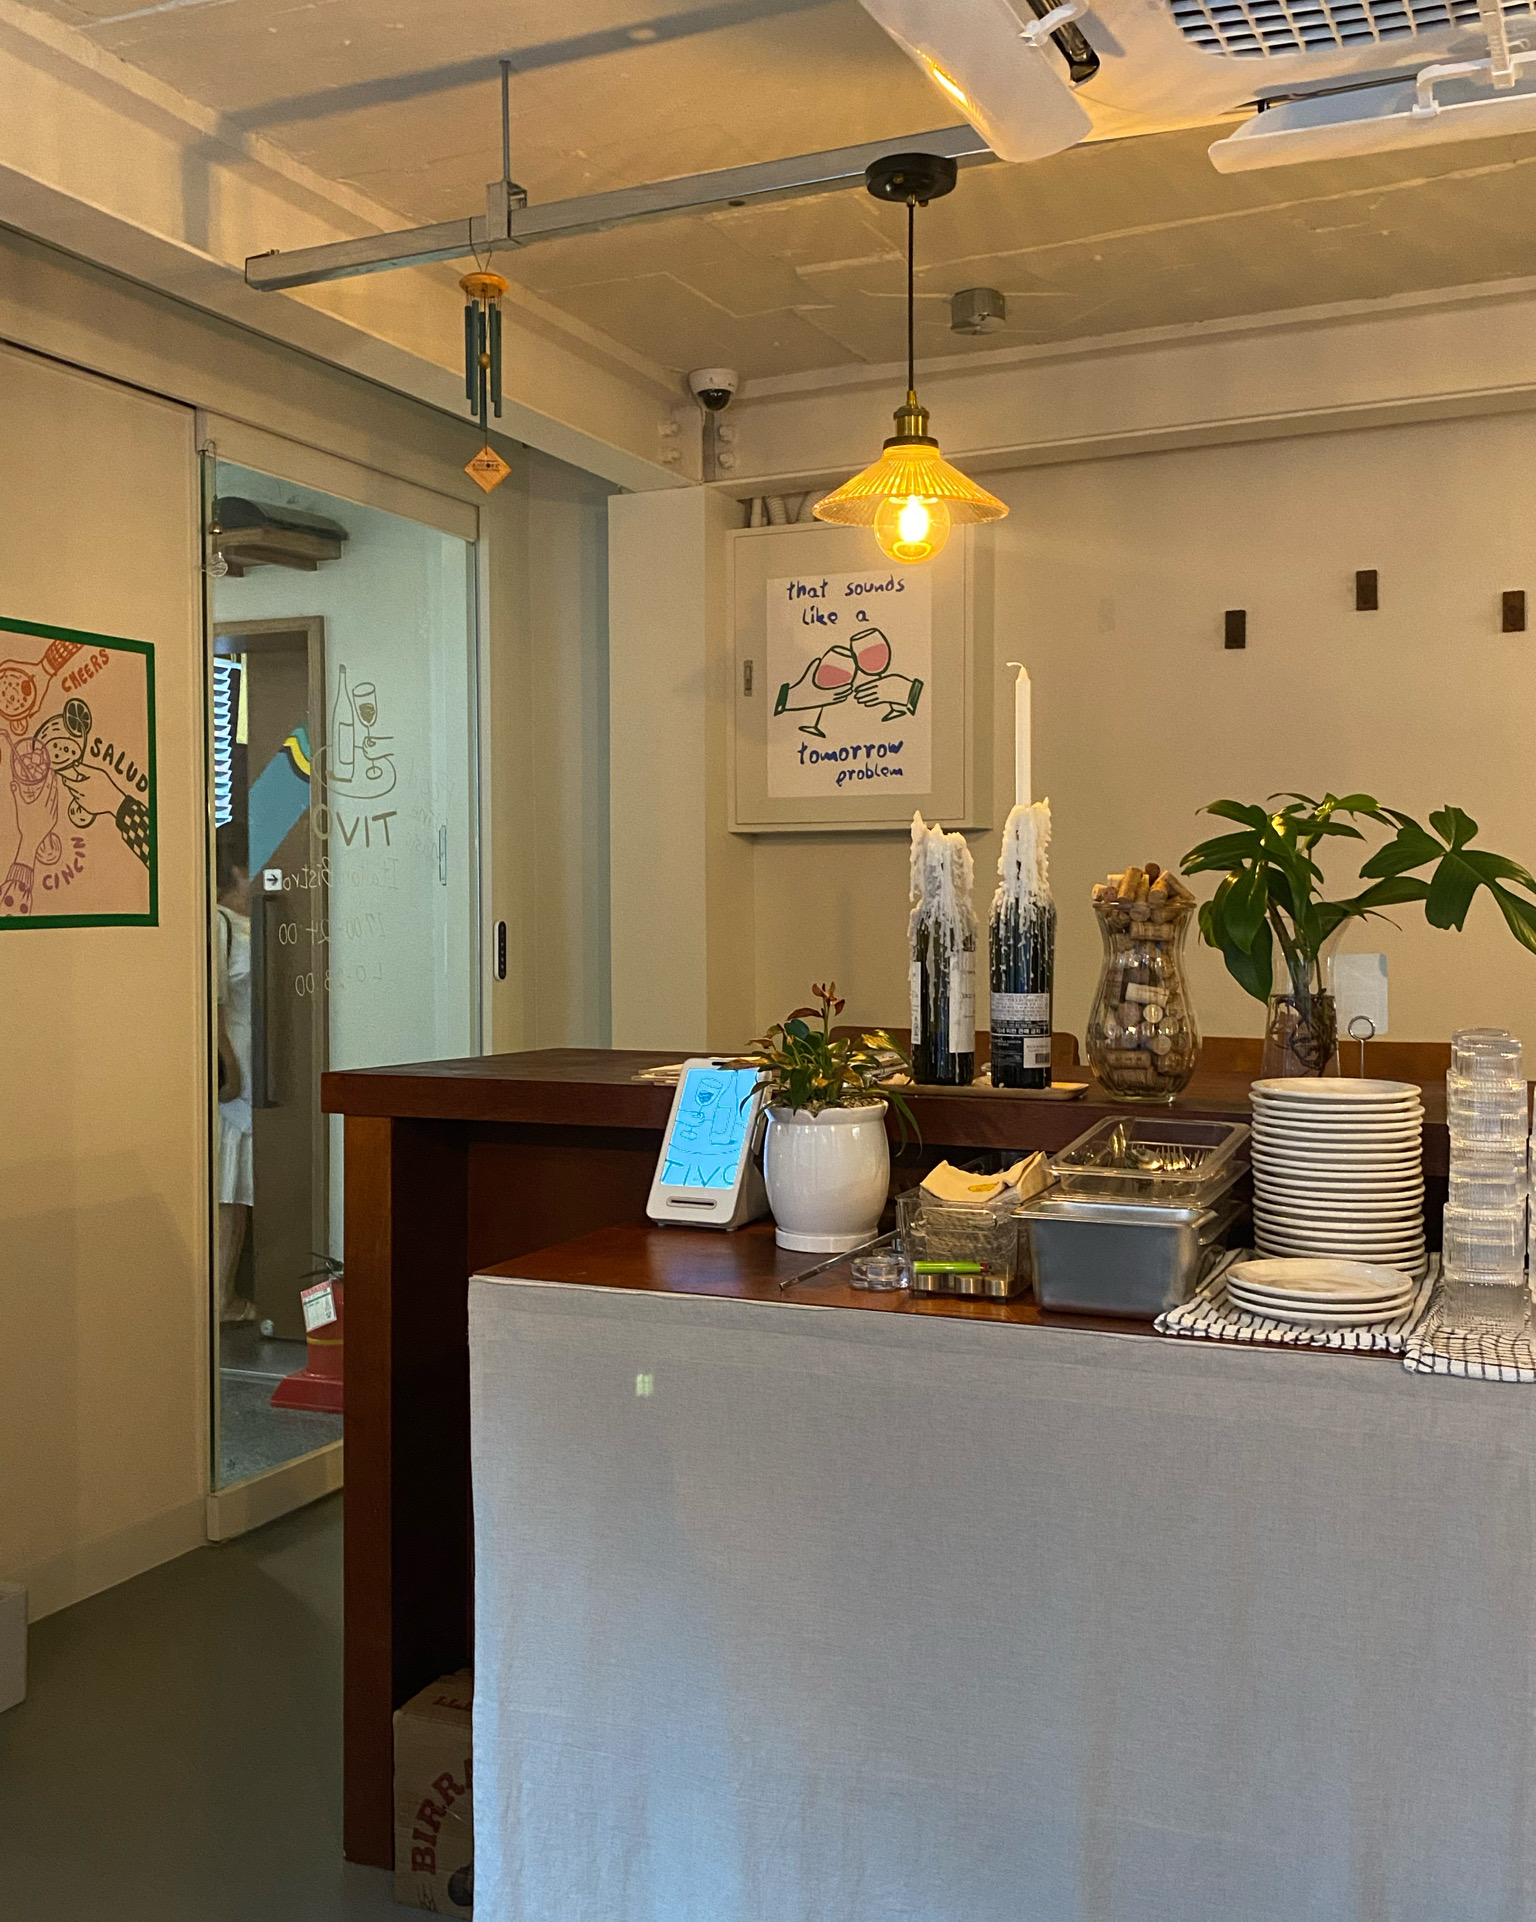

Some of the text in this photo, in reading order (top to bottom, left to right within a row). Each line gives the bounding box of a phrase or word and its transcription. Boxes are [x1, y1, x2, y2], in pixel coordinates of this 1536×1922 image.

[787, 574, 905, 600] that sounds
[802, 605, 870, 626] like a
[61, 648, 110, 693] CHEERS
[90, 737, 148, 792] SALUD
[797, 740, 904, 765] tomorrow
[835, 765, 904, 787] problem
[661, 1158, 739, 1188] TIVO
